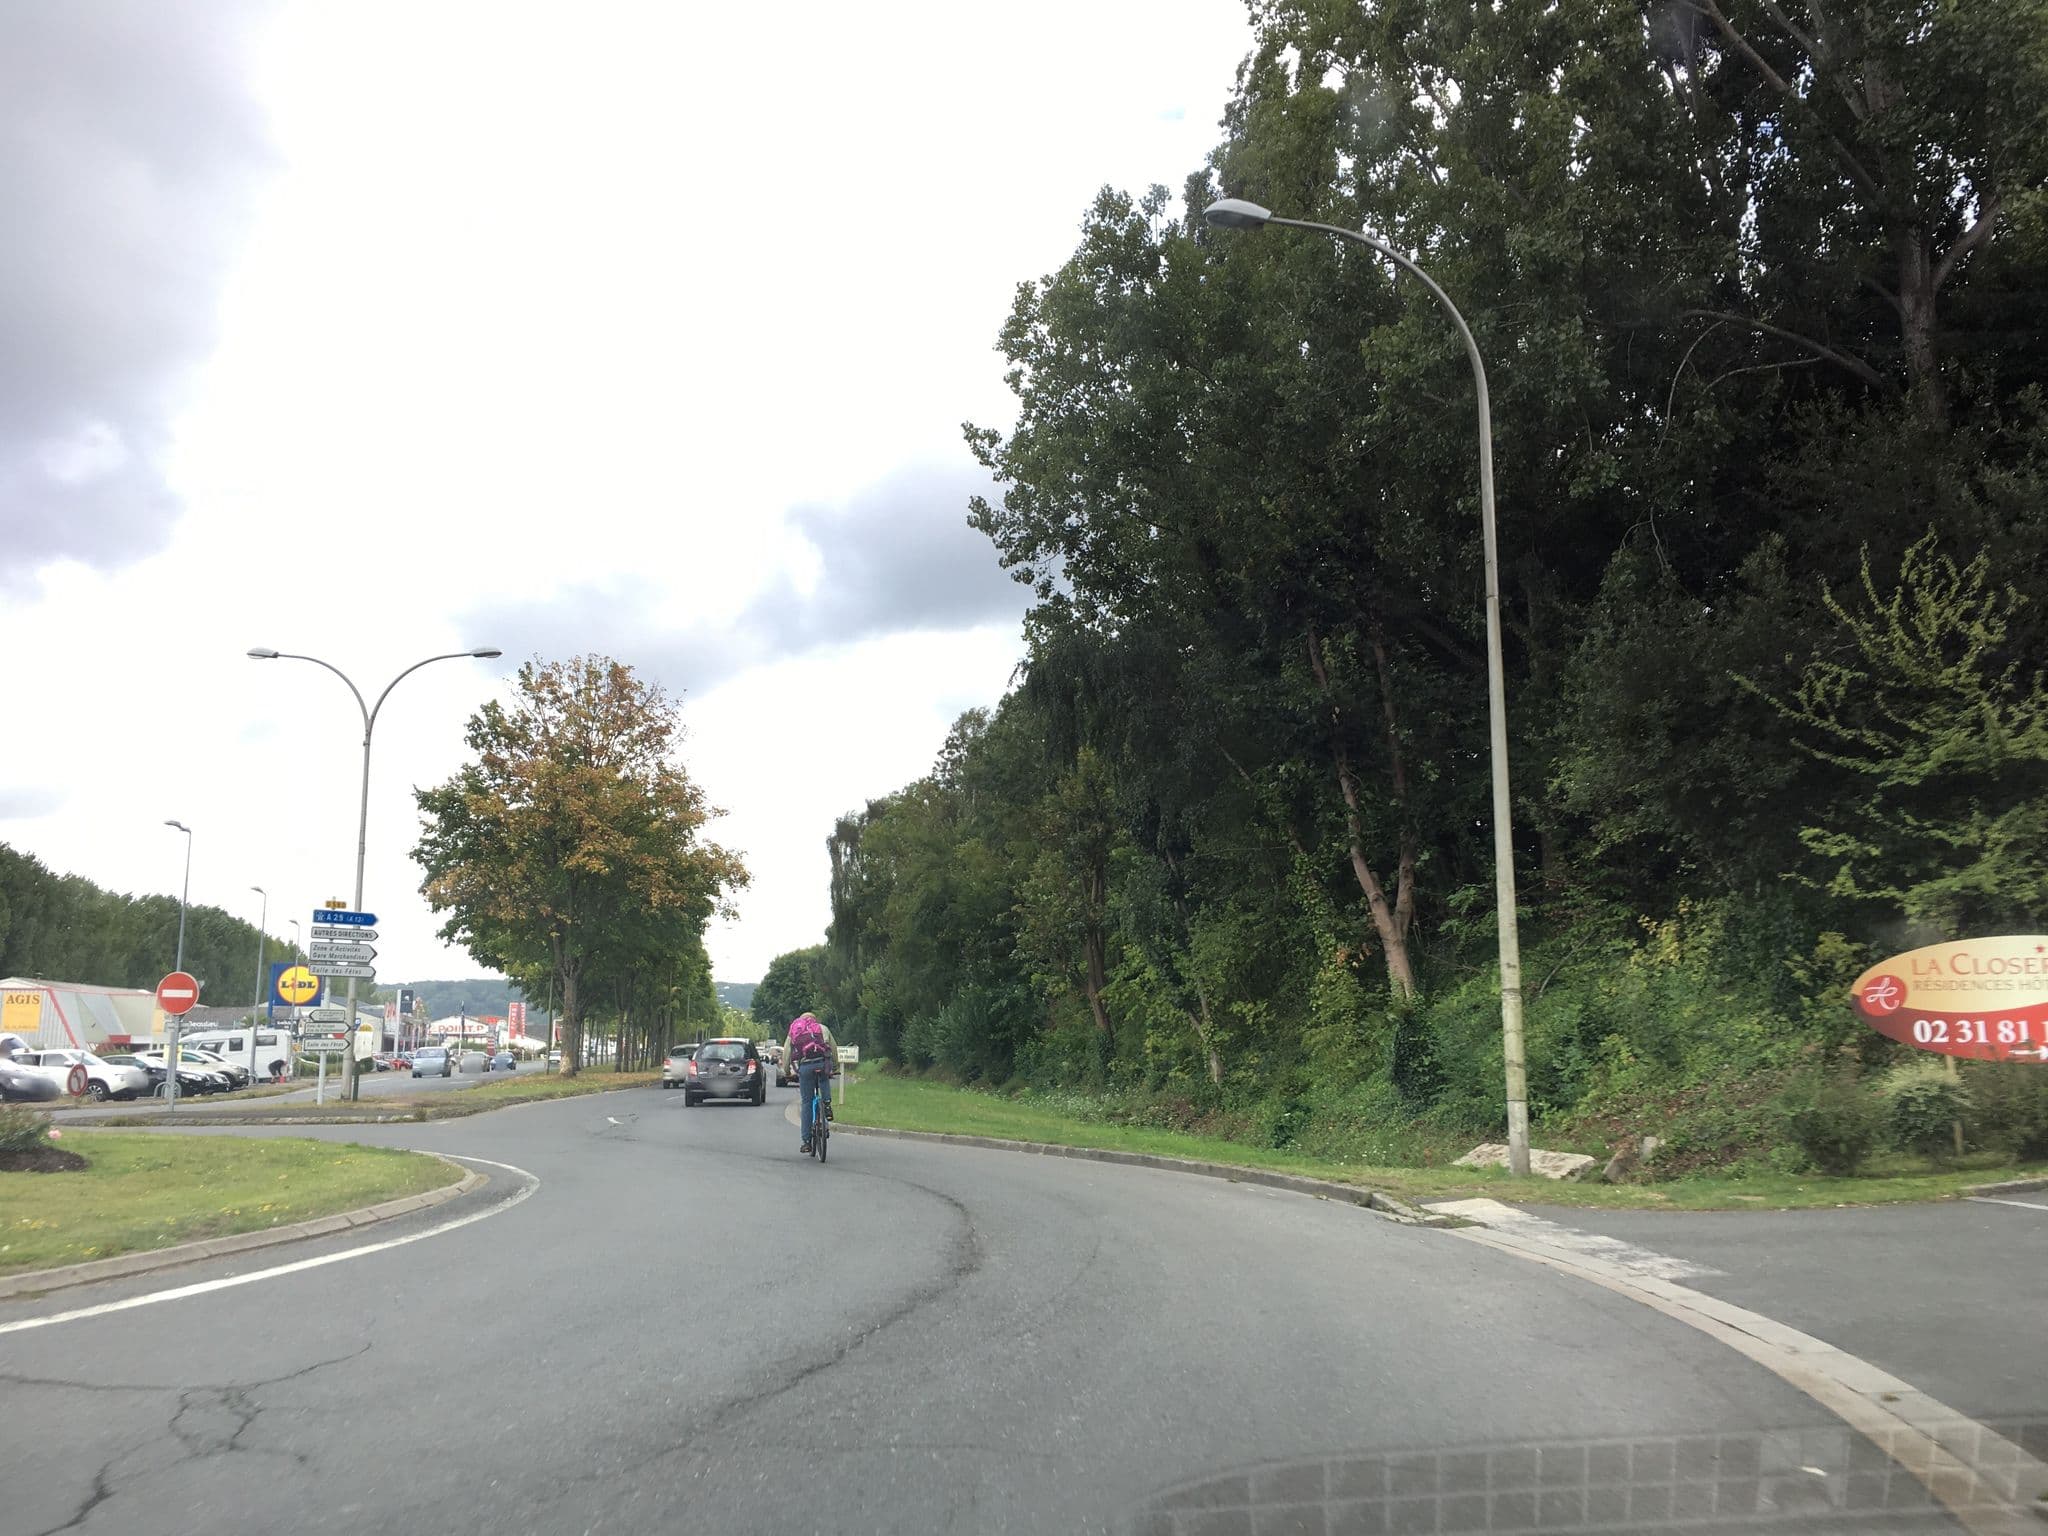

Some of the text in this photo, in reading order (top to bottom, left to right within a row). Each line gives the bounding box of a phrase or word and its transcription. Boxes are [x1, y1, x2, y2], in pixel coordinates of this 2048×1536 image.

[338, 931, 373, 939] DIRECTIONS
[1911, 957, 1943, 975] LA
[6, 994, 40, 1004] AGIS
[1913, 1019, 1949, 1043] 02
[1955, 1019, 1990, 1043] 31
[1997, 1019, 2030, 1043] 81
